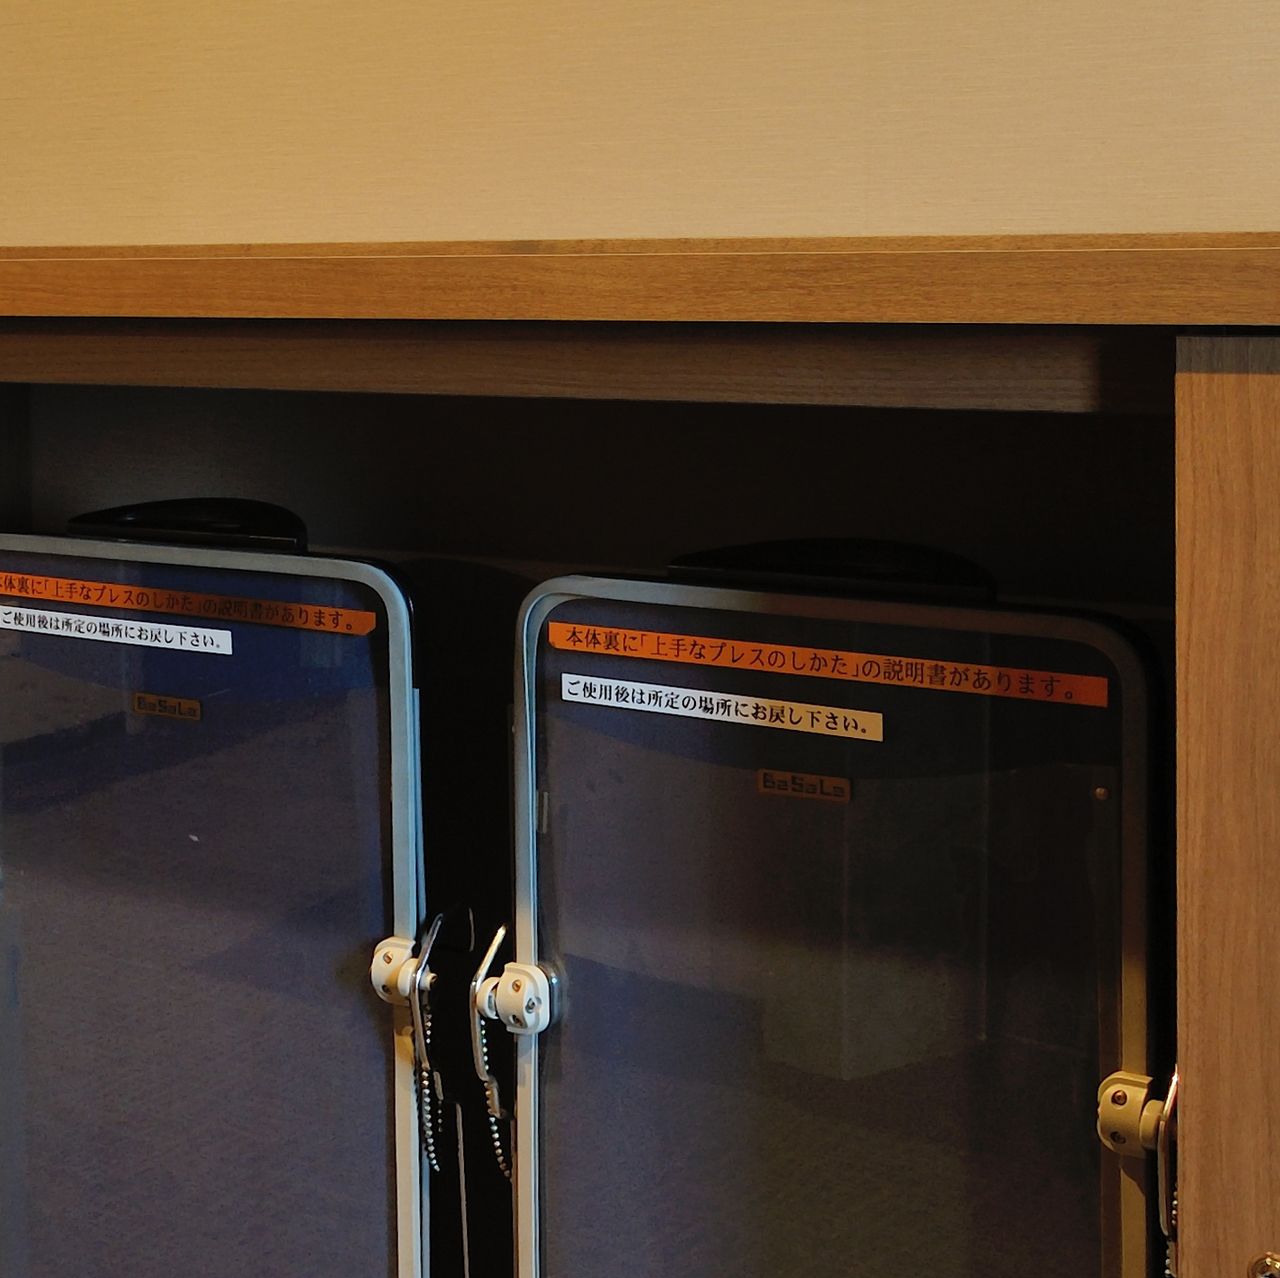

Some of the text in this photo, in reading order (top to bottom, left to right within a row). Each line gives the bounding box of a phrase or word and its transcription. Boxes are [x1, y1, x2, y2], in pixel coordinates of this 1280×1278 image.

[2, 609, 222, 650] ご使用後は所定の場所にお戻し下さい。
[565, 627, 1077, 702] 本体裏に「上手なプレスのしかた」の説明書があります。
[567, 679, 869, 735] ご使用後は所定の場所にお戻し下さい。
